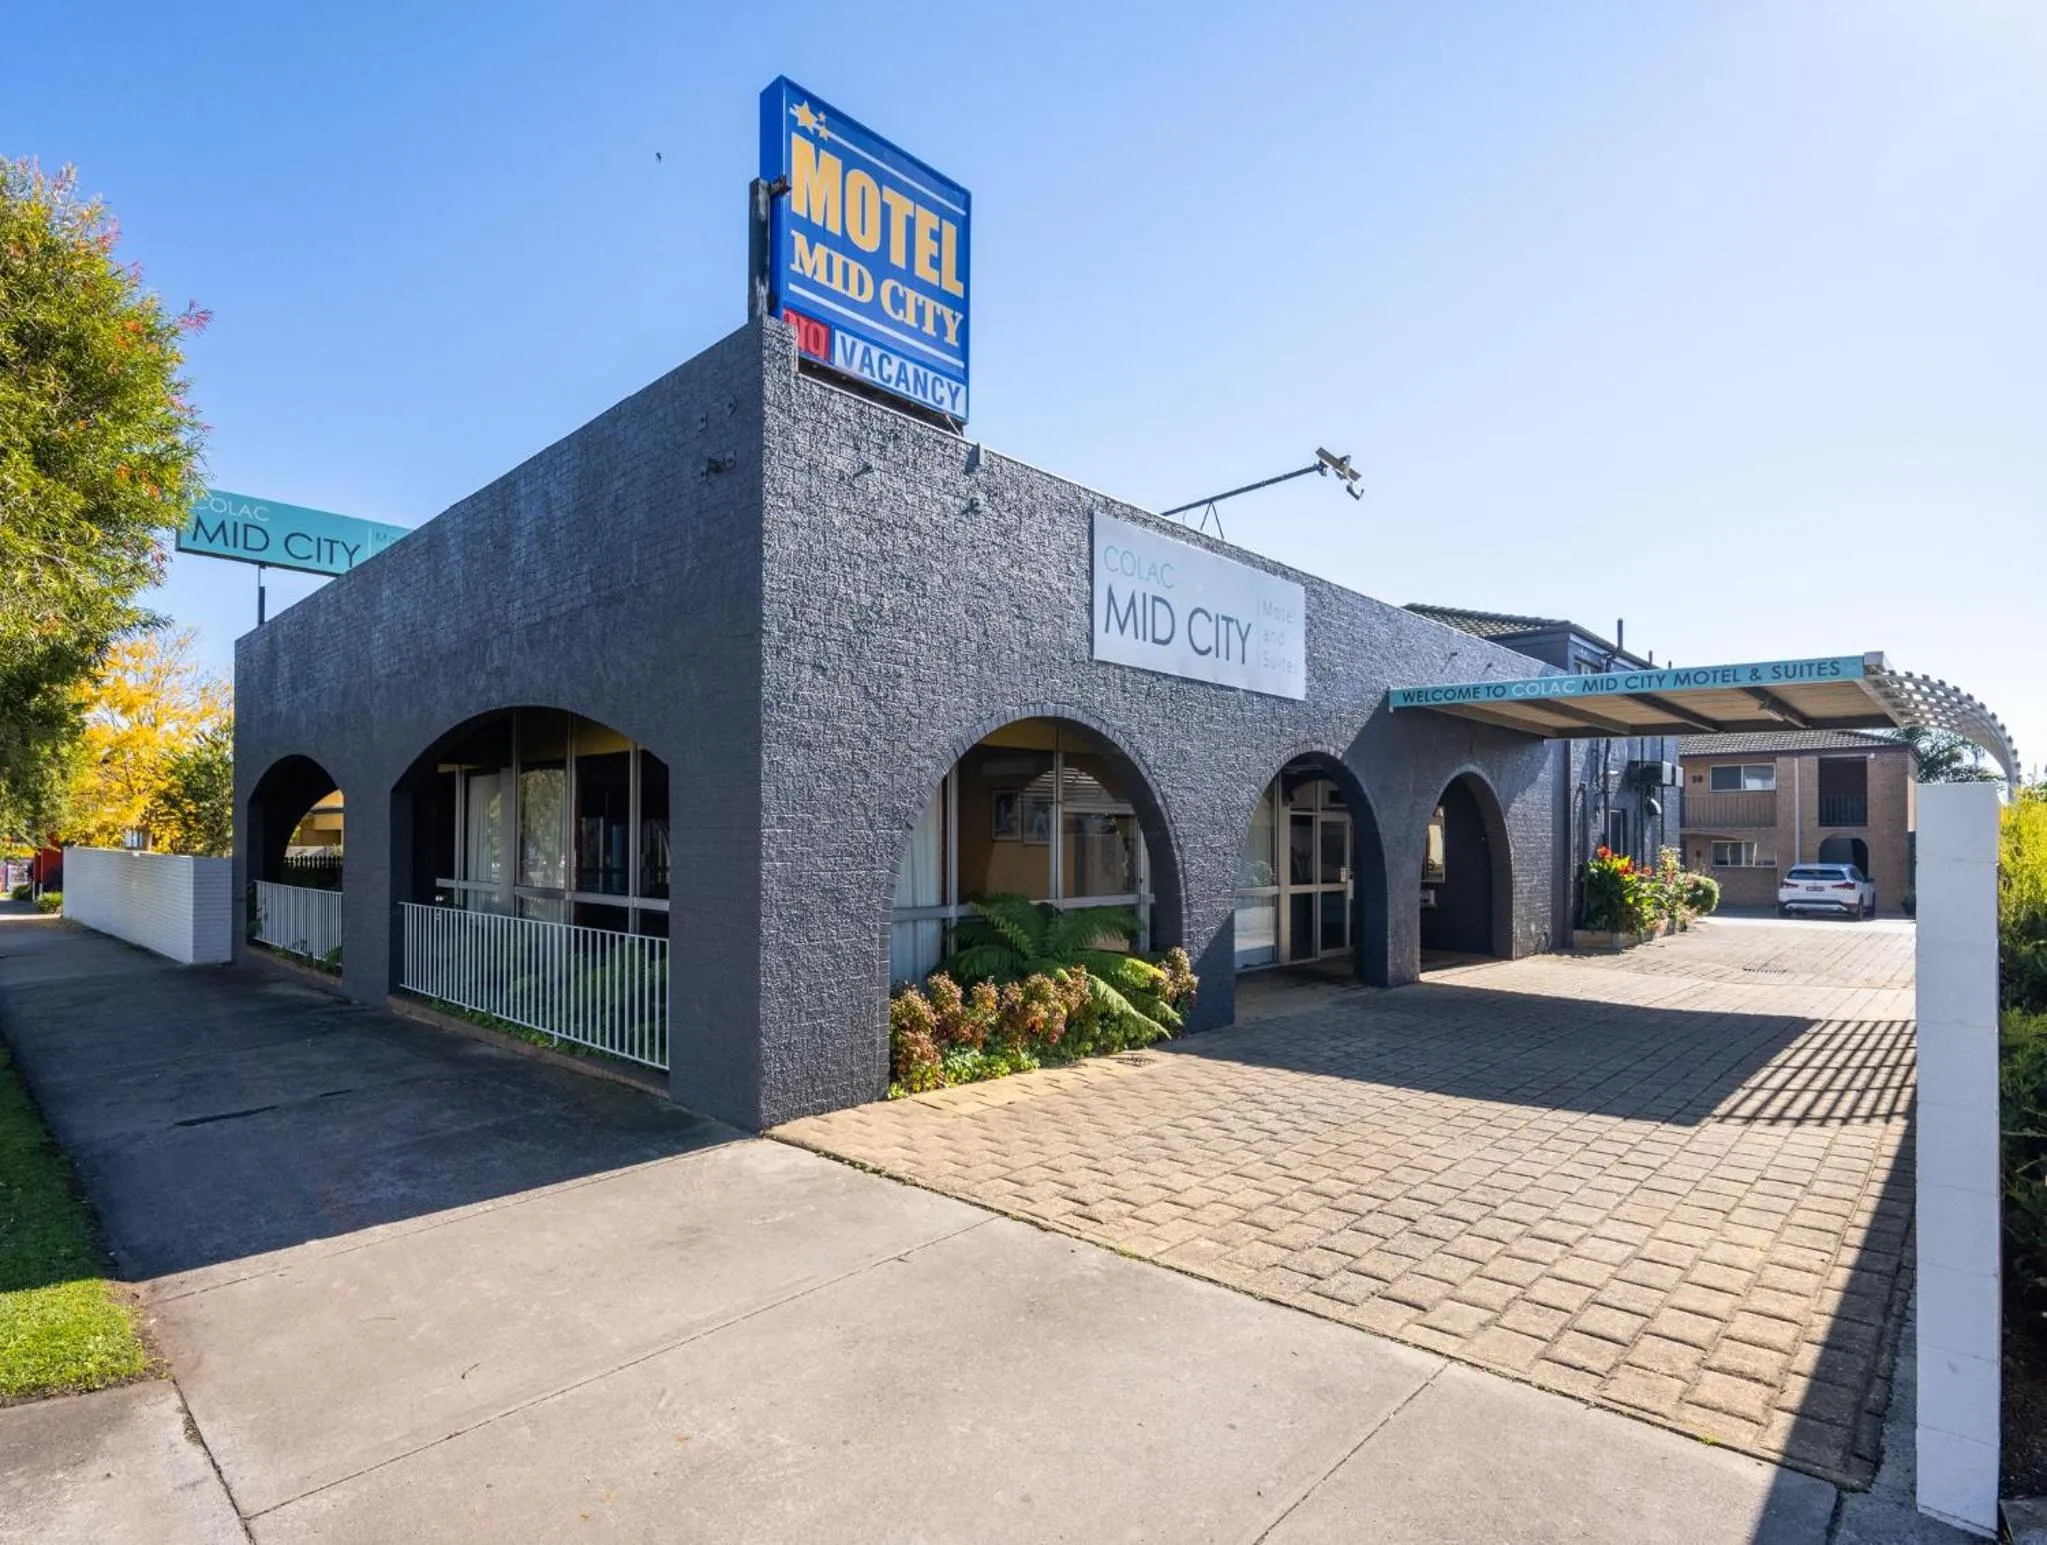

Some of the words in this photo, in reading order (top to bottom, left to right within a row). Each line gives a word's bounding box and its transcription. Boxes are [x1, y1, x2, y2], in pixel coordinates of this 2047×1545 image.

[791, 132, 964, 299] MOTEL
[790, 229, 874, 303] MID
[880, 278, 963, 346] CITY
[838, 334, 961, 411] VACANCY
[192, 515, 270, 552] MID
[284, 532, 361, 568] CITY
[1103, 545, 1174, 589] COLAC
[1104, 582, 1175, 646] MID
[1187, 607, 1252, 665] CITY
[1262, 600, 1296, 624] Motel
[1402, 687, 1480, 703] WELCOME
[1486, 685, 1506, 698] TO
[1511, 680, 1576, 697] COLAC
[1582, 677, 1618, 693] MID
[1625, 674, 1666, 690] CITY
[1674, 668, 1740, 689] MOTEL
[1749, 668, 1762, 681] &
[1771, 660, 1841, 680] SUITES
